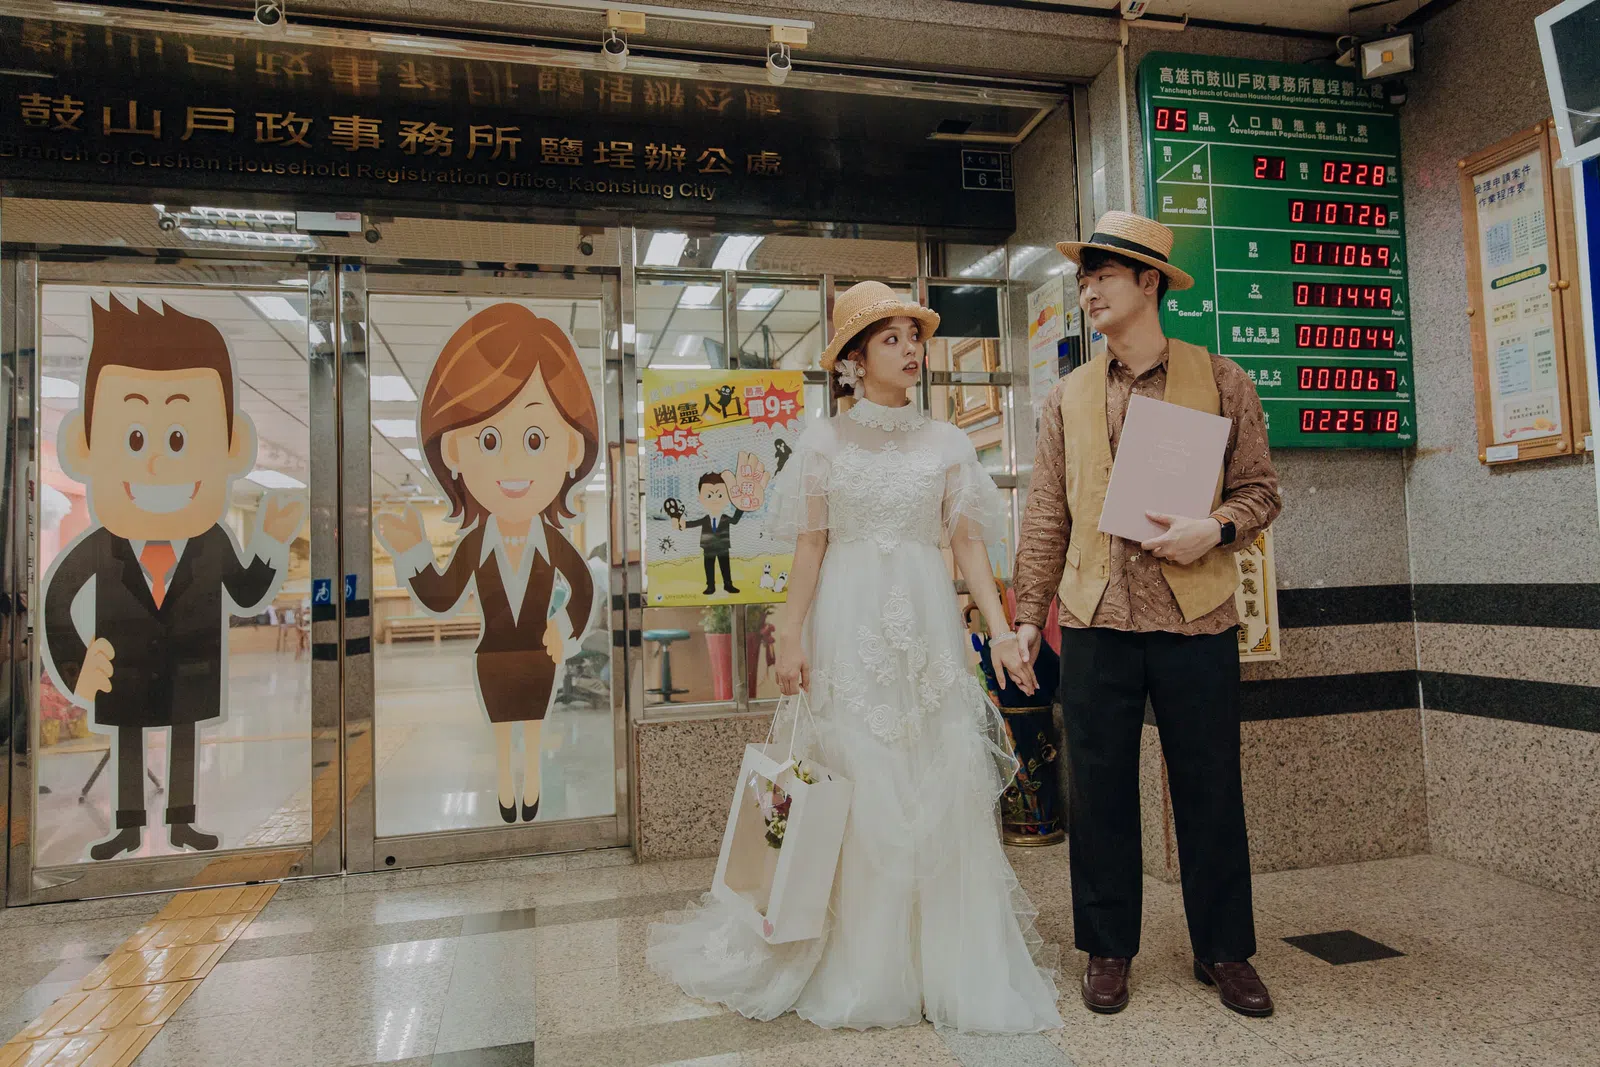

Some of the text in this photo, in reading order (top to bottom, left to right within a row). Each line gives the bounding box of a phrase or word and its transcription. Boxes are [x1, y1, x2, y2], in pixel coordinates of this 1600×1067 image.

[1160, 86, 1191, 95] Yancheng
[1193, 88, 1215, 96] Branch
[1248, 92, 1281, 101] Household
[1282, 95, 1319, 104] Registration
[1156, 109, 1187, 131] 05
[1198, 112, 1209, 125] 月
[1192, 124, 1216, 132] Month
[1230, 126, 1368, 143] Development Population Statistic Table
[99, 149, 121, 164] of
[228, 156, 350, 178] Household
[357, 162, 489, 185] Registration
[569, 176, 674, 199] Kaohsiung
[679, 182, 717, 201] City
[1255, 158, 1285, 179] 21
[1323, 162, 1385, 186] 0228
[979, 173, 987, 186] 6
[1292, 201, 1386, 226] 010726
[1389, 211, 1399, 222] 戶
[1248, 242, 1257, 252] 男
[1294, 243, 1389, 267] 011069
[1392, 252, 1400, 263] 人
[1250, 283, 1260, 293] 女
[1297, 284, 1391, 307] 011449
[1394, 293, 1403, 304] 人
[1298, 325, 1394, 349] 000044
[1396, 334, 1406, 345] 人
[1247, 369, 1282, 380] 住民女
[1300, 368, 1396, 390] 000067
[1399, 375, 1408, 386] 人
[653, 393, 742, 427] 幽靈人口
[1302, 410, 1398, 431] 022518
[1401, 415, 1410, 426] 人
